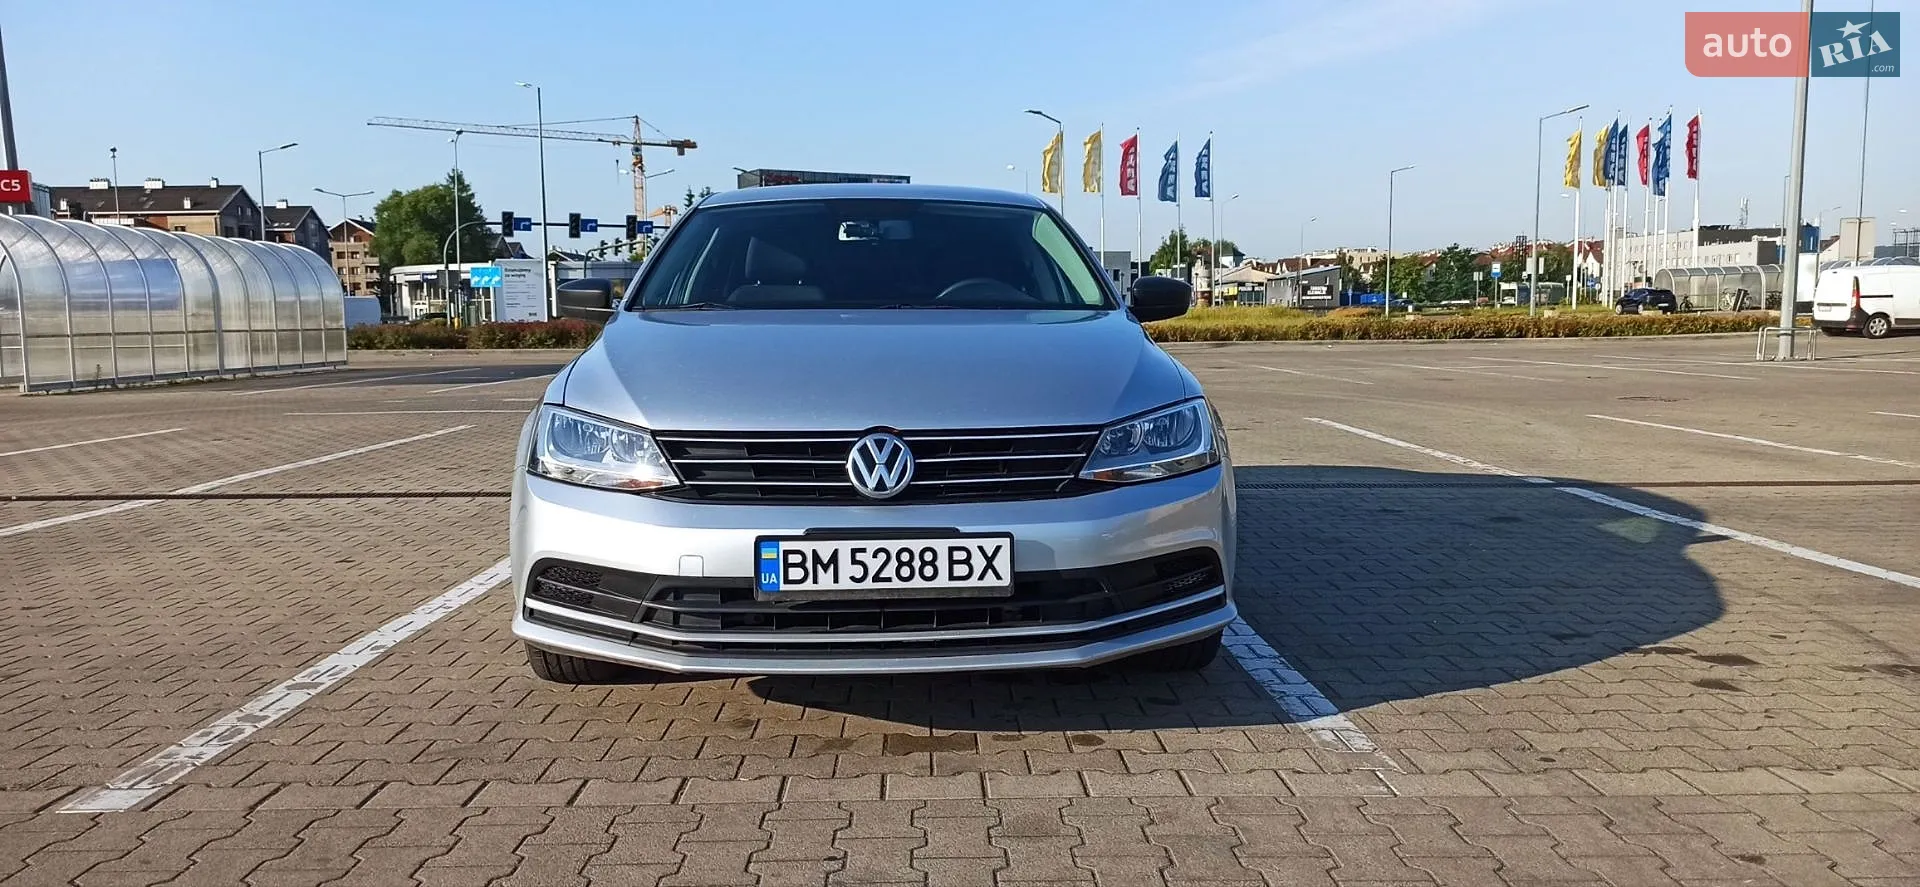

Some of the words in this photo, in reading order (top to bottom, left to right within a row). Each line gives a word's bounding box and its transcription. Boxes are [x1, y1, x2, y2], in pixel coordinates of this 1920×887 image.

[0, 179, 21, 192] C5
[782, 548, 840, 585] BM
[849, 546, 939, 584] 5288
[948, 545, 1003, 582] BX
[761, 572, 778, 585] UA
